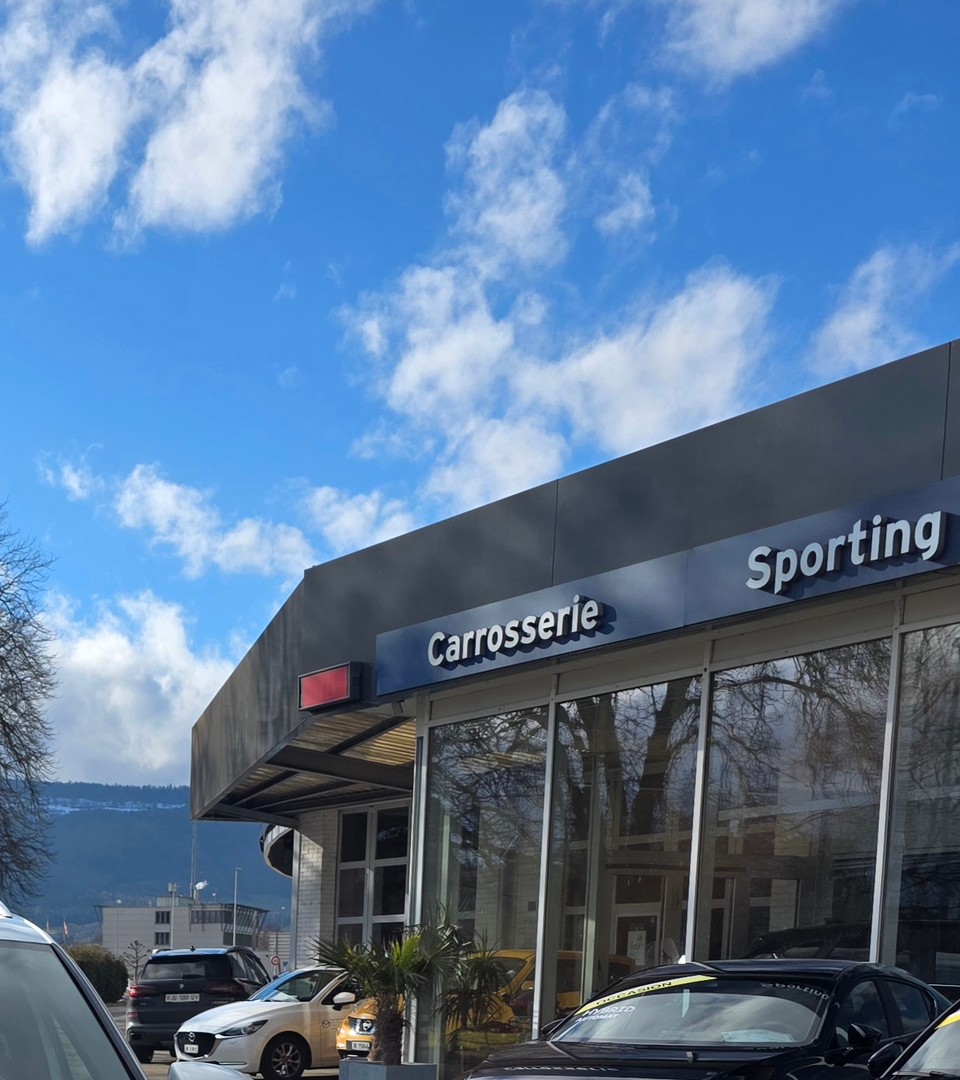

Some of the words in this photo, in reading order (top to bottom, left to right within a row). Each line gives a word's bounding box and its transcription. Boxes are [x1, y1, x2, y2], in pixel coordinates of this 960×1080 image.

[428, 594, 599, 666] Carrosserie
[746, 511, 941, 594] Sporting
[596, 981, 672, 1005] OCCASION
[574, 1013, 620, 1023] AUTOMAT
[582, 1005, 636, 1017] HYBRID
